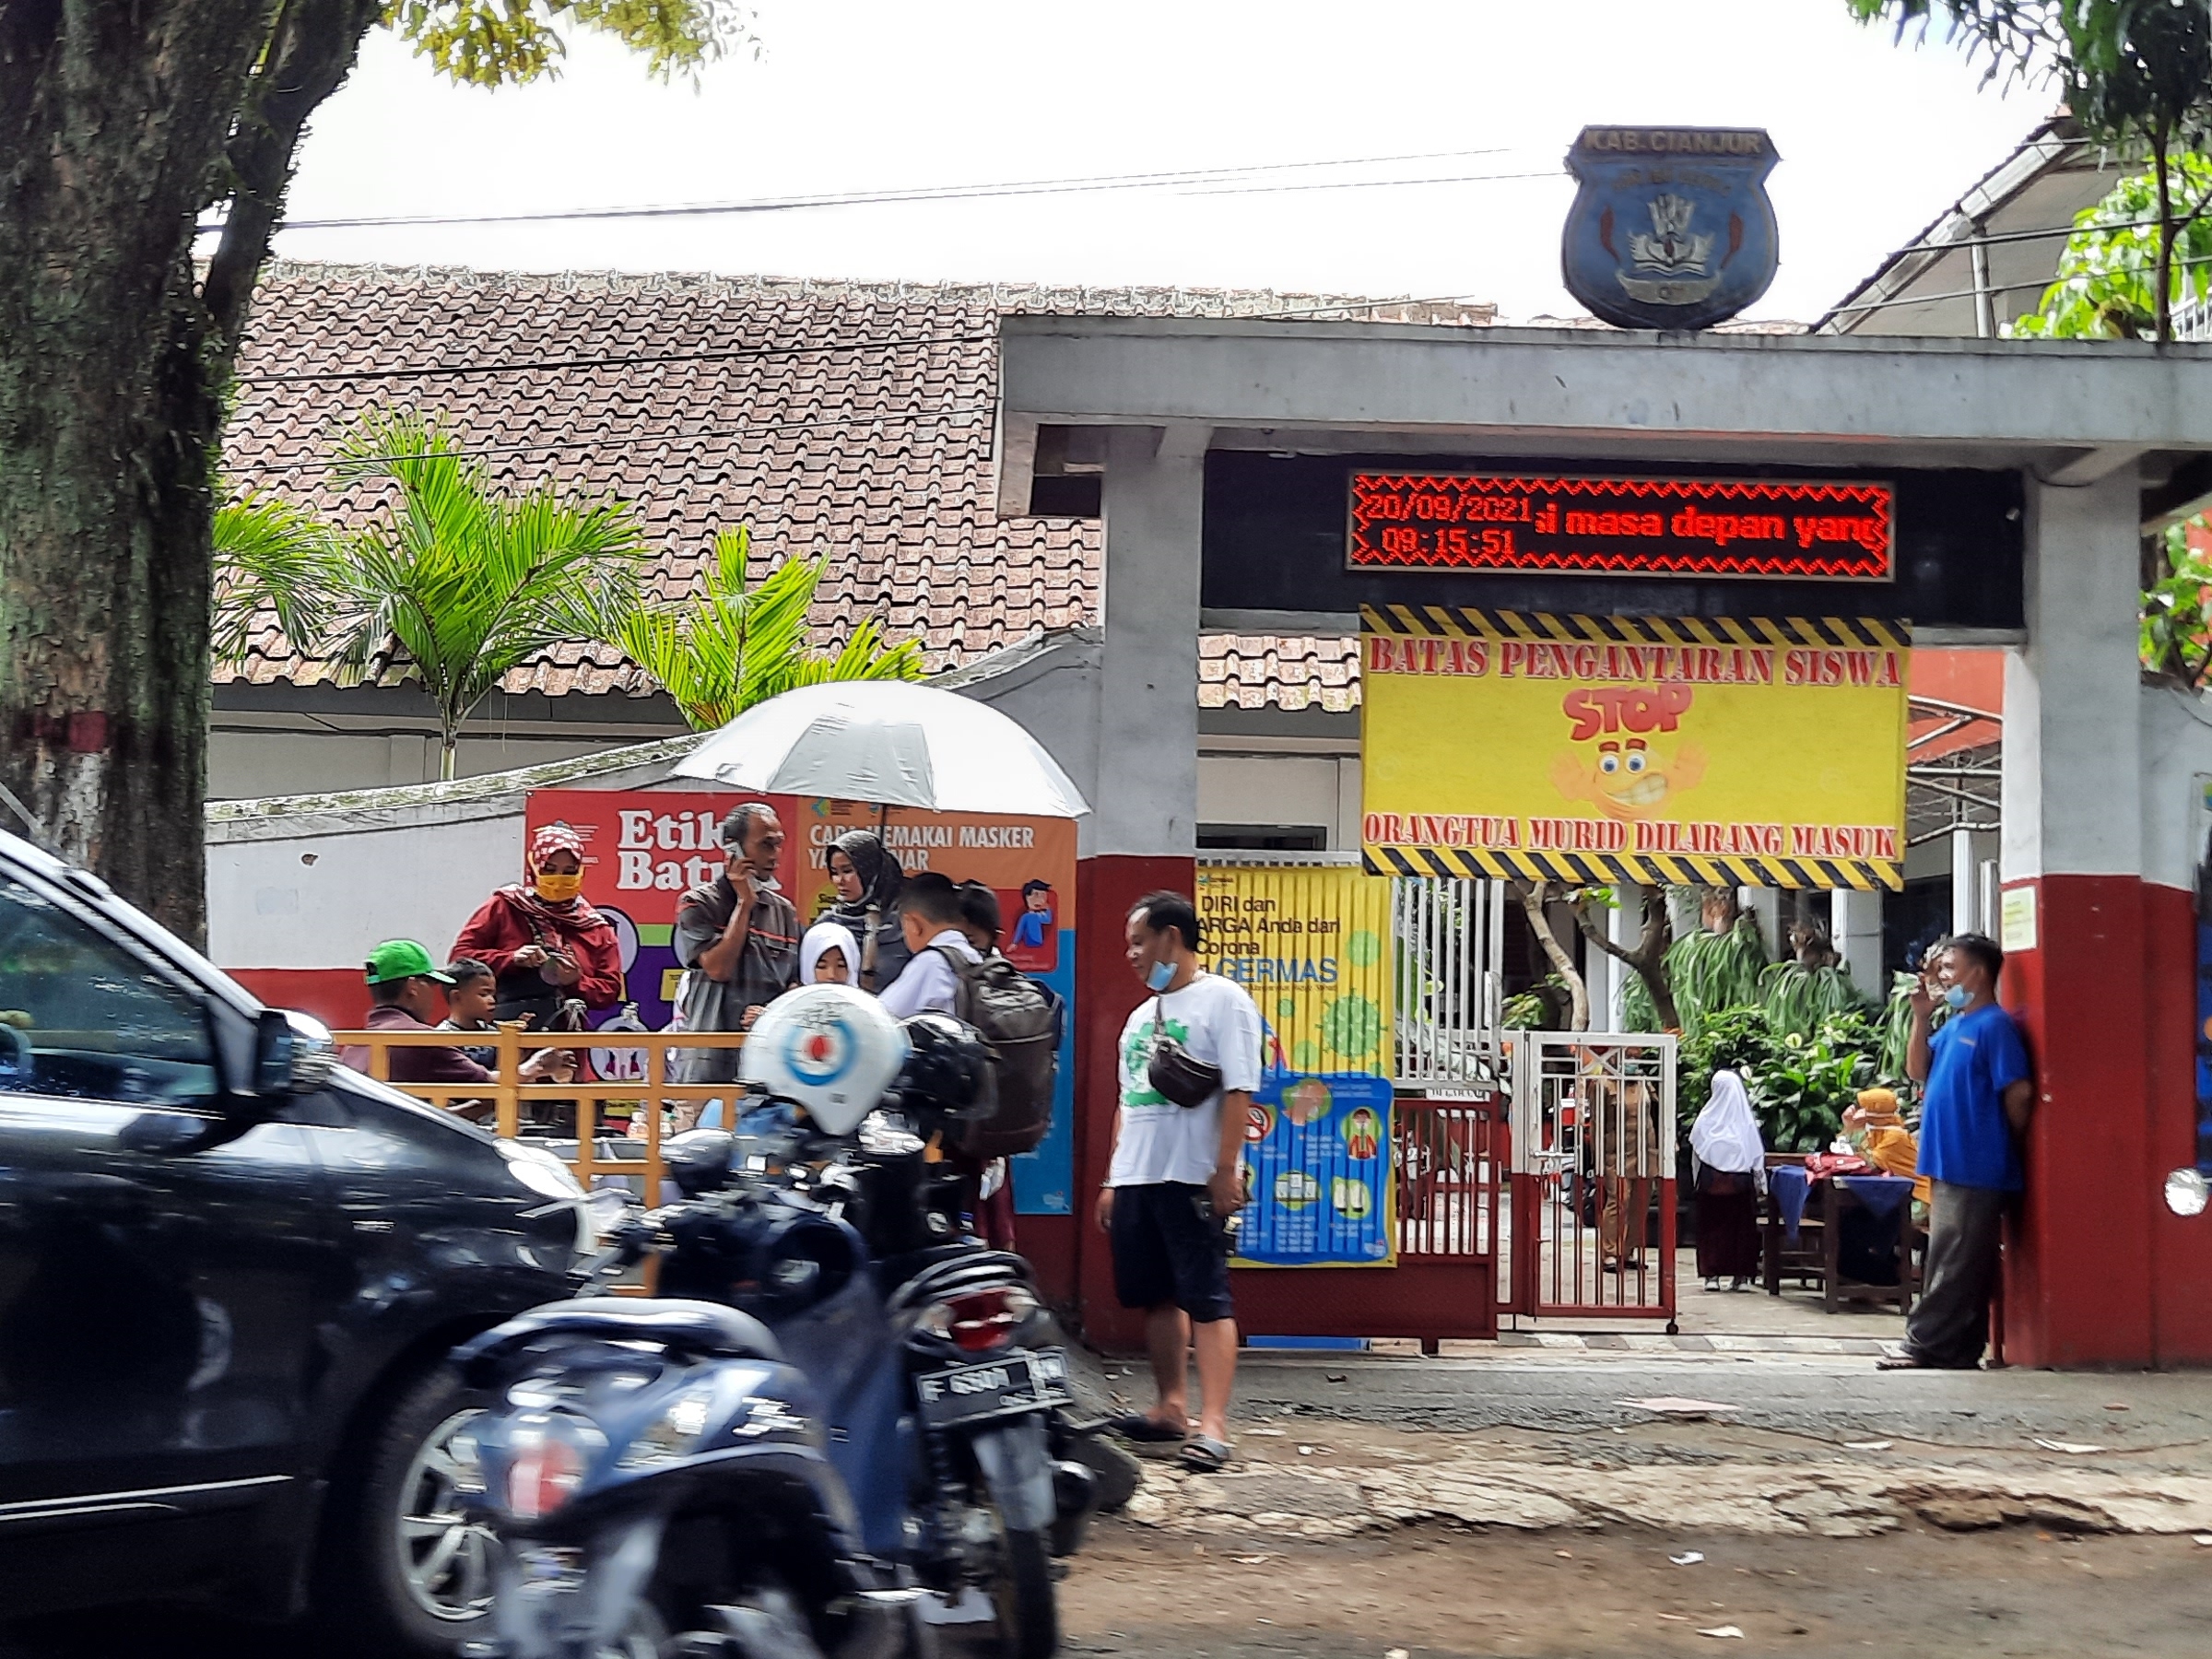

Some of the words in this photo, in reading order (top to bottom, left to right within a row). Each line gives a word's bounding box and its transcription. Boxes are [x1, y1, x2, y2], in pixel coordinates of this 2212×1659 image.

[1651, 131, 1762, 154] CIANJUR
[1366, 492, 1532, 522] 20/09/2021
[1565, 511, 1663, 536] masa
[1671, 504, 1785, 547] depan
[1369, 637, 1489, 677] BATAS
[1499, 641, 1774, 686] PENGANTARAN
[1784, 649, 1902, 688] SISWA
[1562, 684, 1693, 742] STOP
[959, 827, 1034, 849] MASKER
[1362, 813, 1523, 850] ORANGTUA
[1527, 817, 1628, 853] MURID
[1634, 819, 1784, 856] DILARANG
[1790, 824, 1899, 859] MASUK
[1202, 896, 1239, 912] DIRI
[1243, 896, 1277, 912] dan
[1197, 918, 1251, 934] ARGA
[1257, 918, 1302, 934] Anda
[1307, 917, 1340, 934] dari
[1196, 938, 1260, 955] Corona
[1217, 958, 1338, 982] GERMAS
